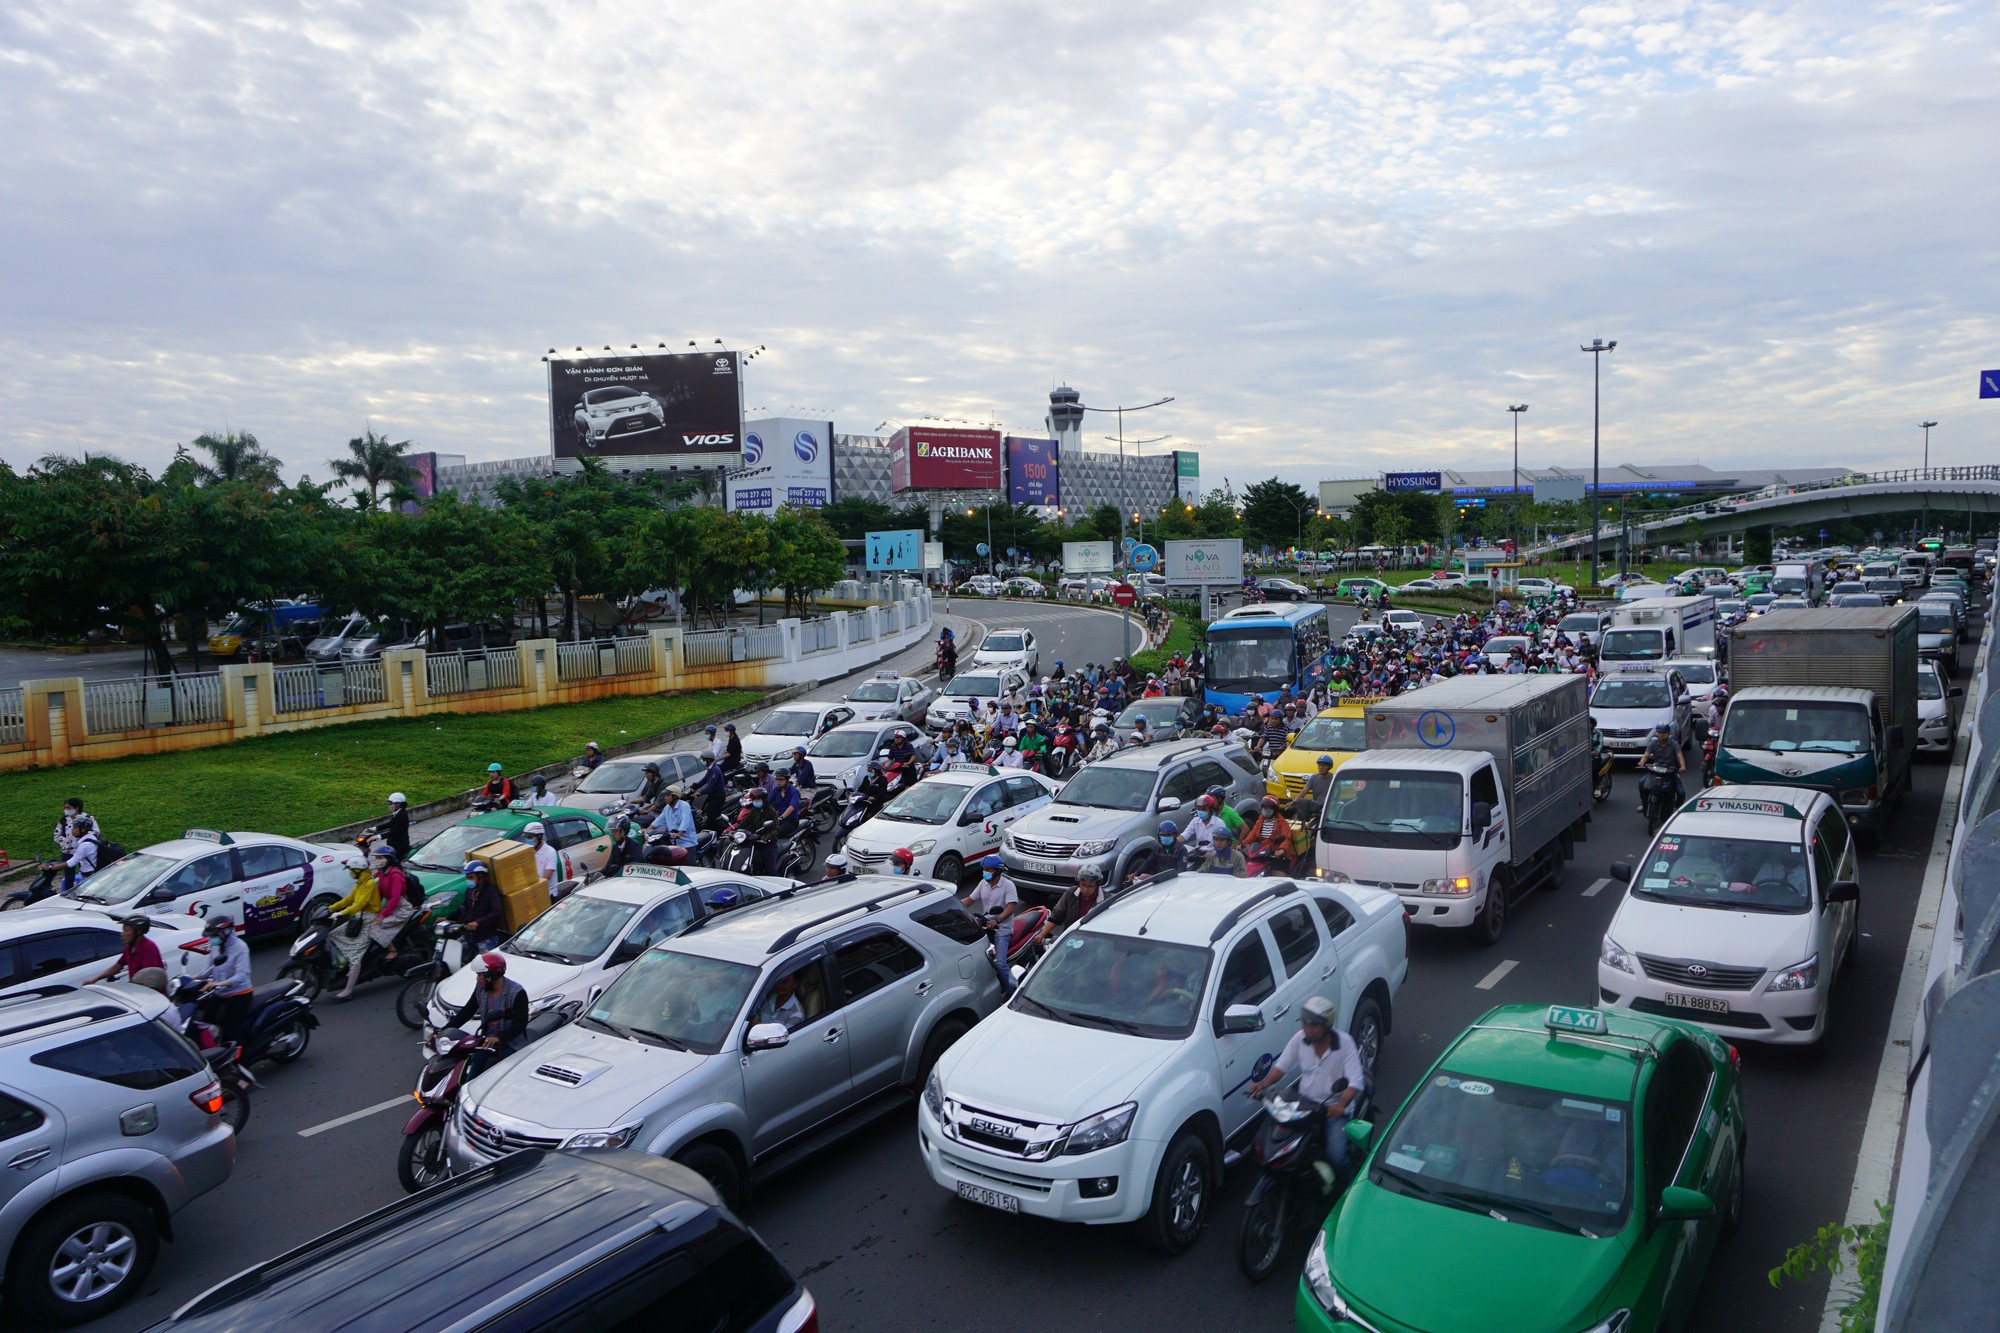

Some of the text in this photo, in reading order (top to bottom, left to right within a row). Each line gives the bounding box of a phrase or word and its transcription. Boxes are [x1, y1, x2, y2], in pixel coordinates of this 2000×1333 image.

[583, 366, 604, 374] HÀNH
[682, 434, 734, 446] VIOS
[930, 446, 992, 459] AGRIBANK
[1023, 463, 1047, 479] 1500
[1388, 476, 1437, 487] HYOSUNG
[736, 499, 749, 507] 0918
[1185, 551, 1219, 562] NOVA
[1185, 564, 1220, 572] LAND
[1659, 843, 1679, 851] 7539
[971, 1117, 1014, 1138] ISUZU
